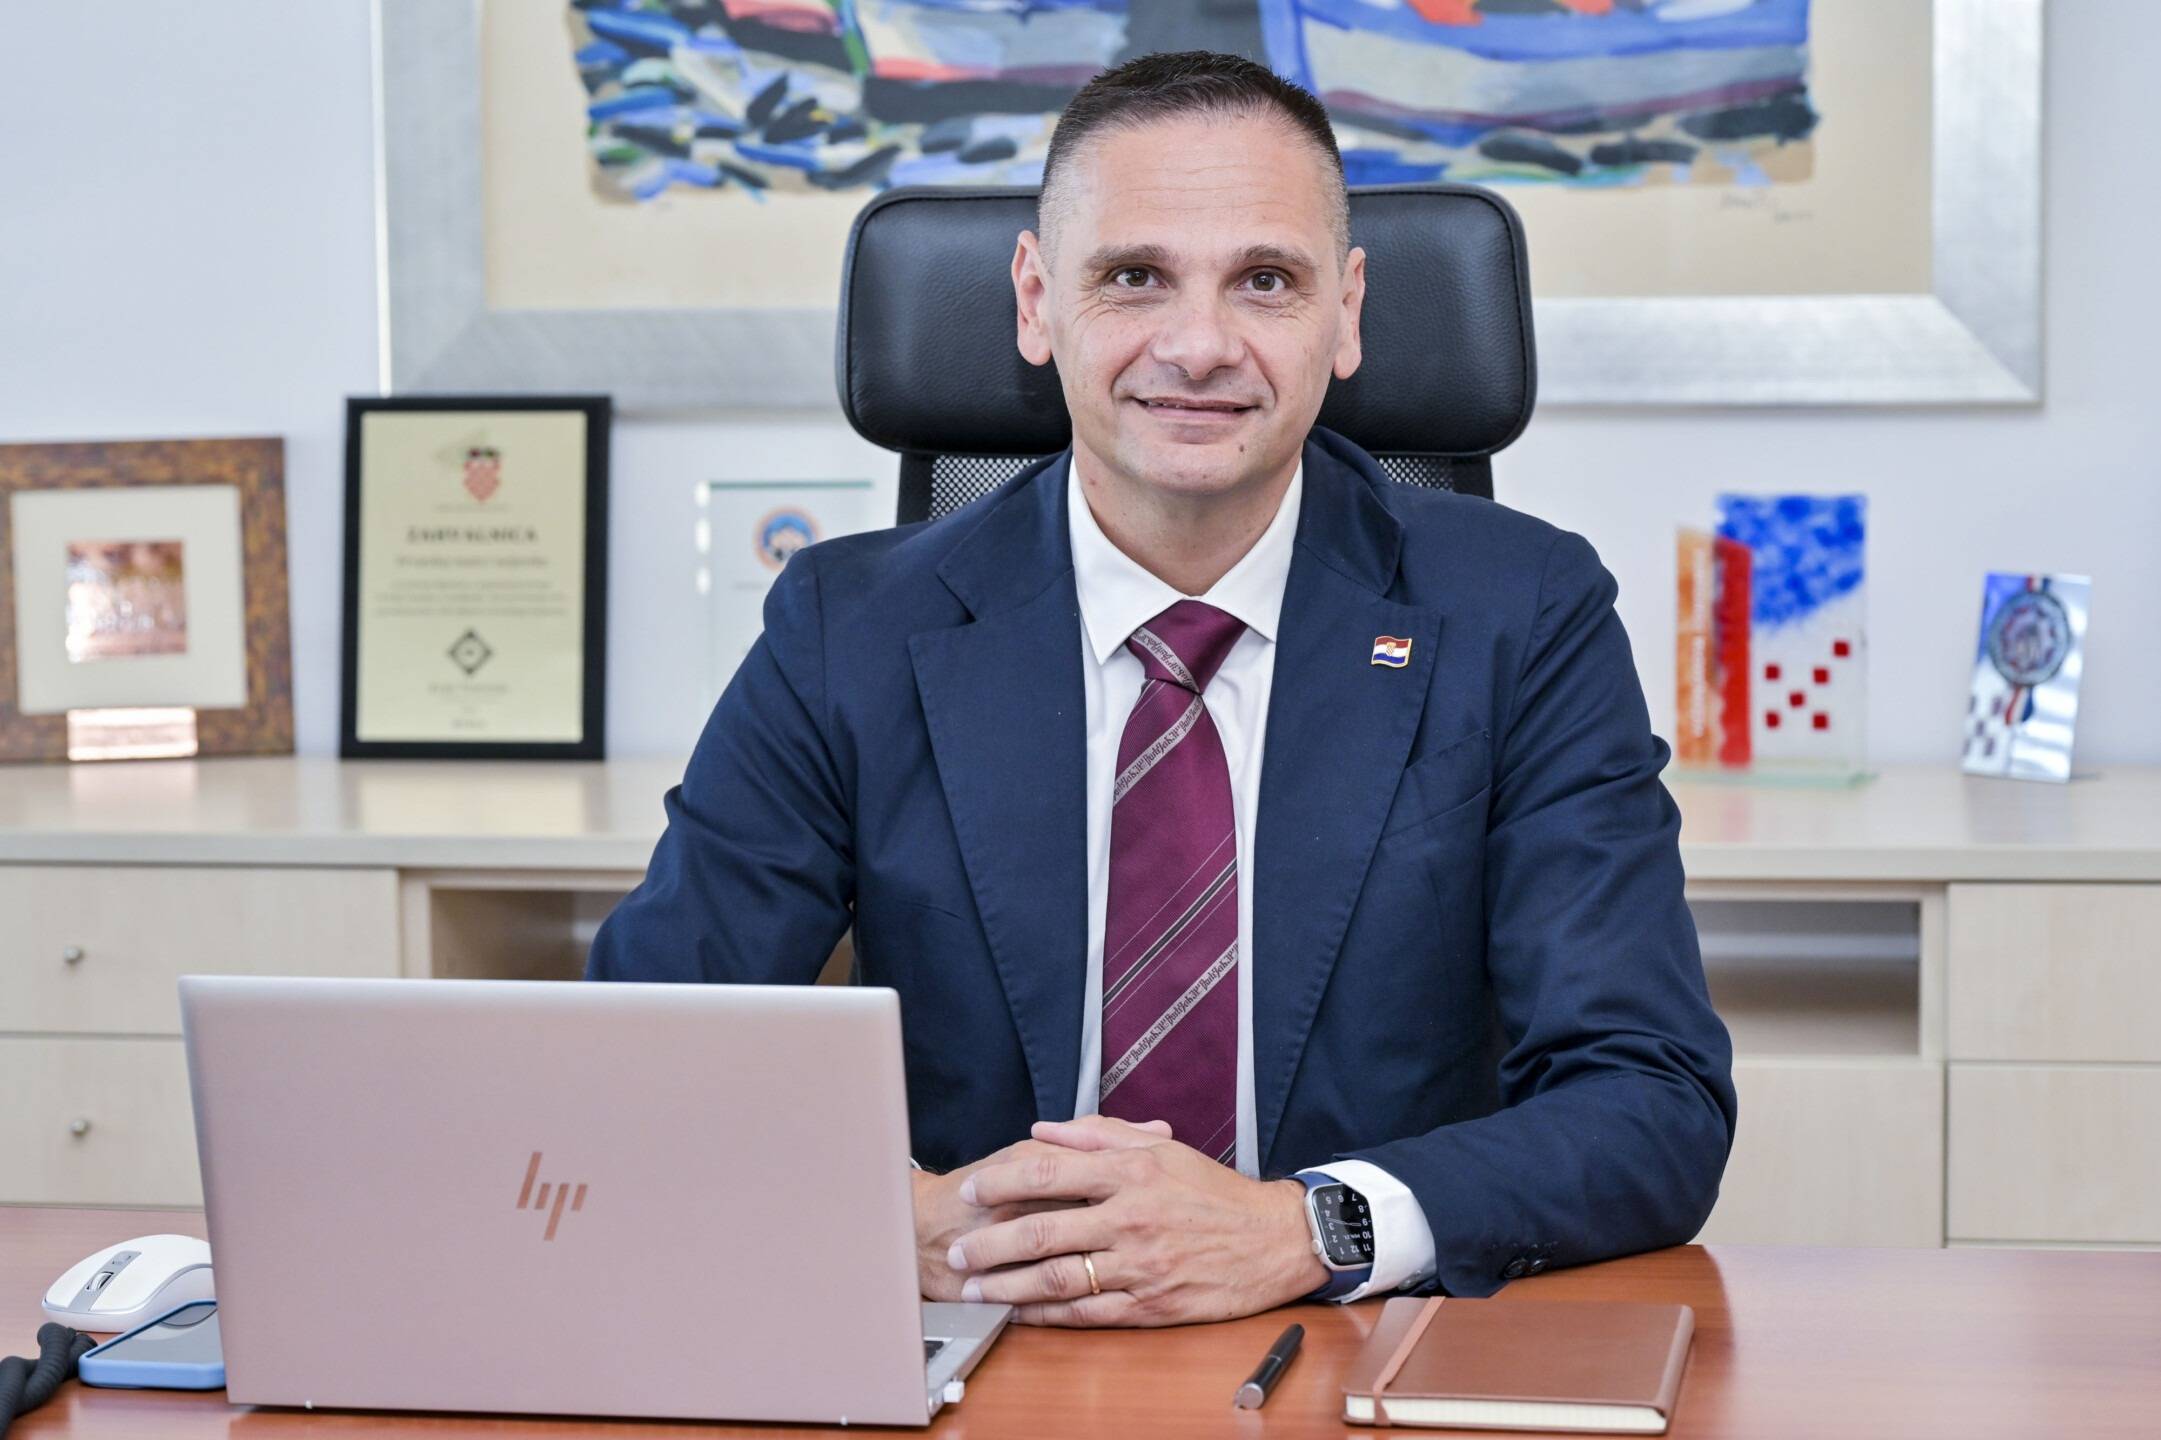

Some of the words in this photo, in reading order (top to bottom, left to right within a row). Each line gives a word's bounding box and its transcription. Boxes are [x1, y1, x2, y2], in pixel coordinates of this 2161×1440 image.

[516, 1151, 588, 1242] hp
[1338, 1195, 1344, 1203] 6
[1352, 1194, 1357, 1202] 7
[1326, 1197, 1332, 1205] 5
[1324, 1209, 1331, 1217] 4
[1358, 1205, 1365, 1213] 8
[1328, 1223, 1335, 1231] 3
[1331, 1235, 1338, 1243] 2
[1362, 1232, 1372, 1240] 10
[1339, 1247, 1345, 1255] 1
[1350, 1245, 1360, 1254] 12
[1363, 1244, 1371, 1252] 11
